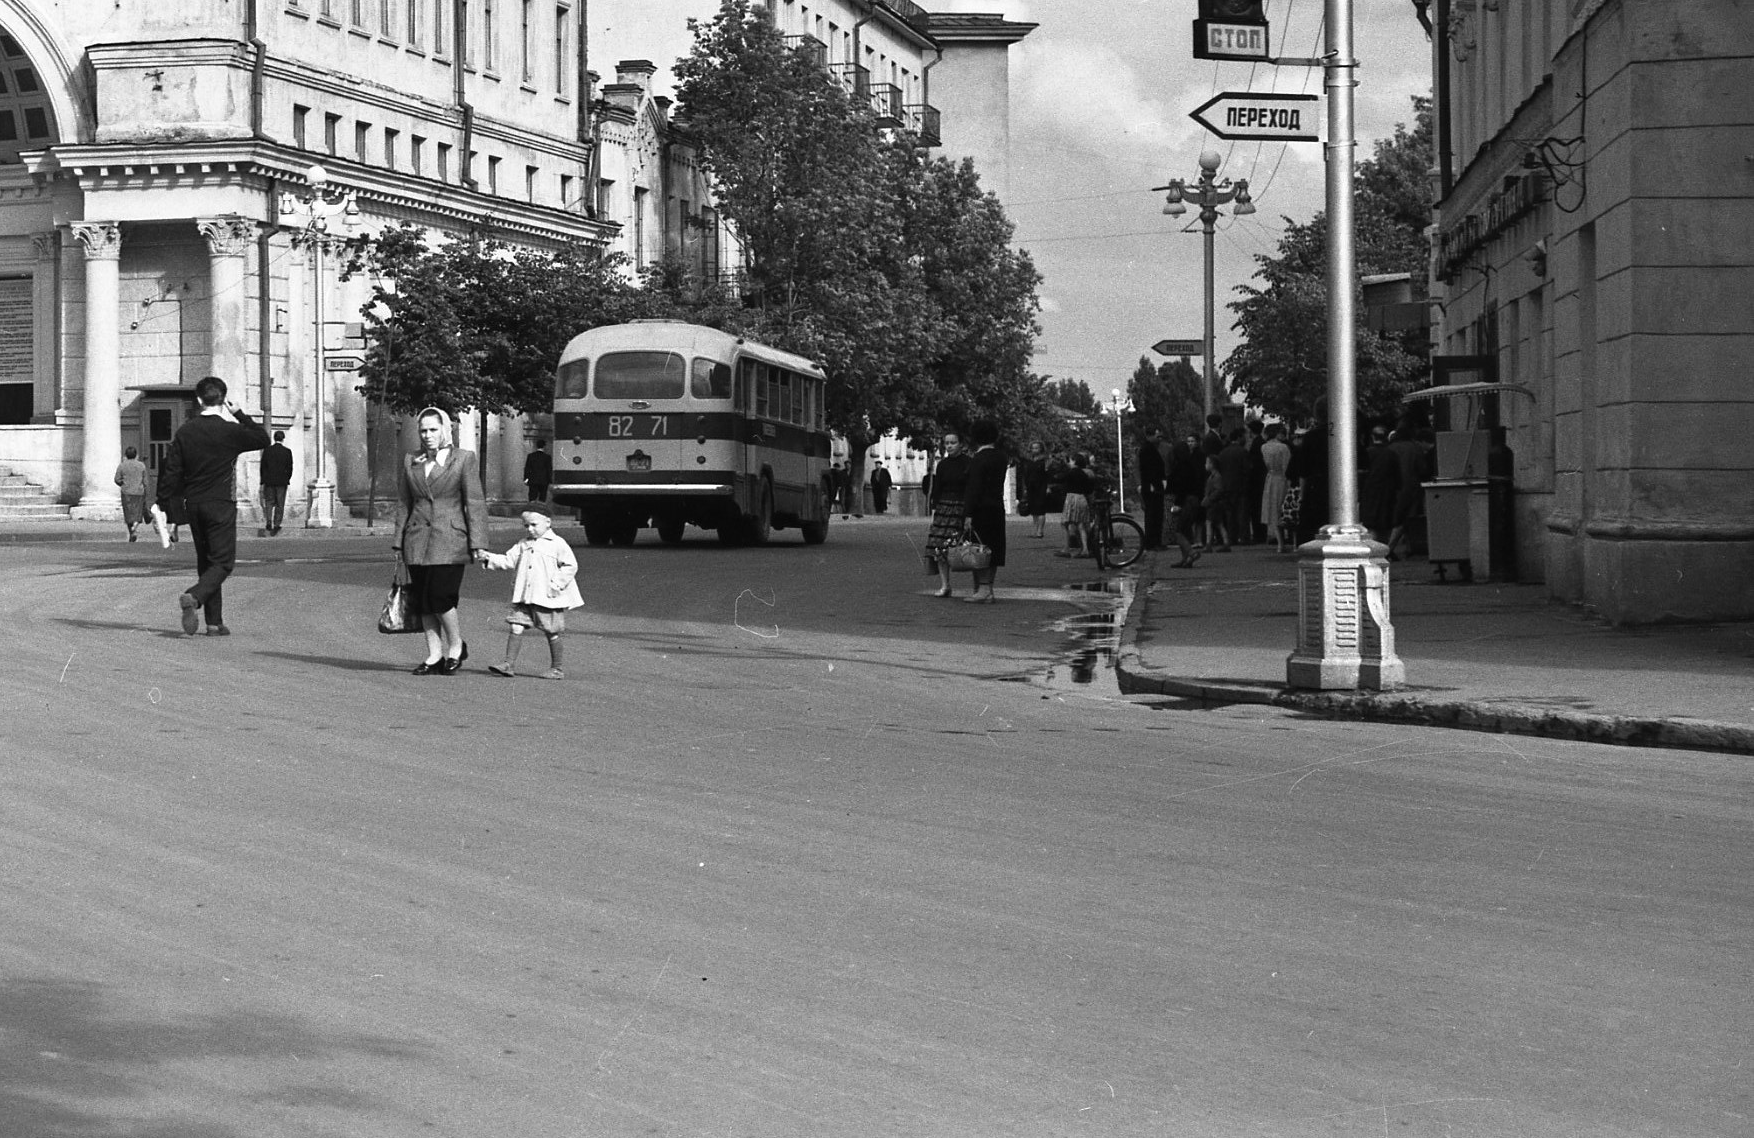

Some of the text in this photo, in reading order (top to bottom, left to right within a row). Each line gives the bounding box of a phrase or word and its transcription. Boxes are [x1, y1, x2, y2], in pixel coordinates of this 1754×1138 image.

[1210, 27, 1261, 49] СТОП
[1227, 106, 1301, 130] ПЕРЕХОД
[609, 415, 667, 436] 82 71
